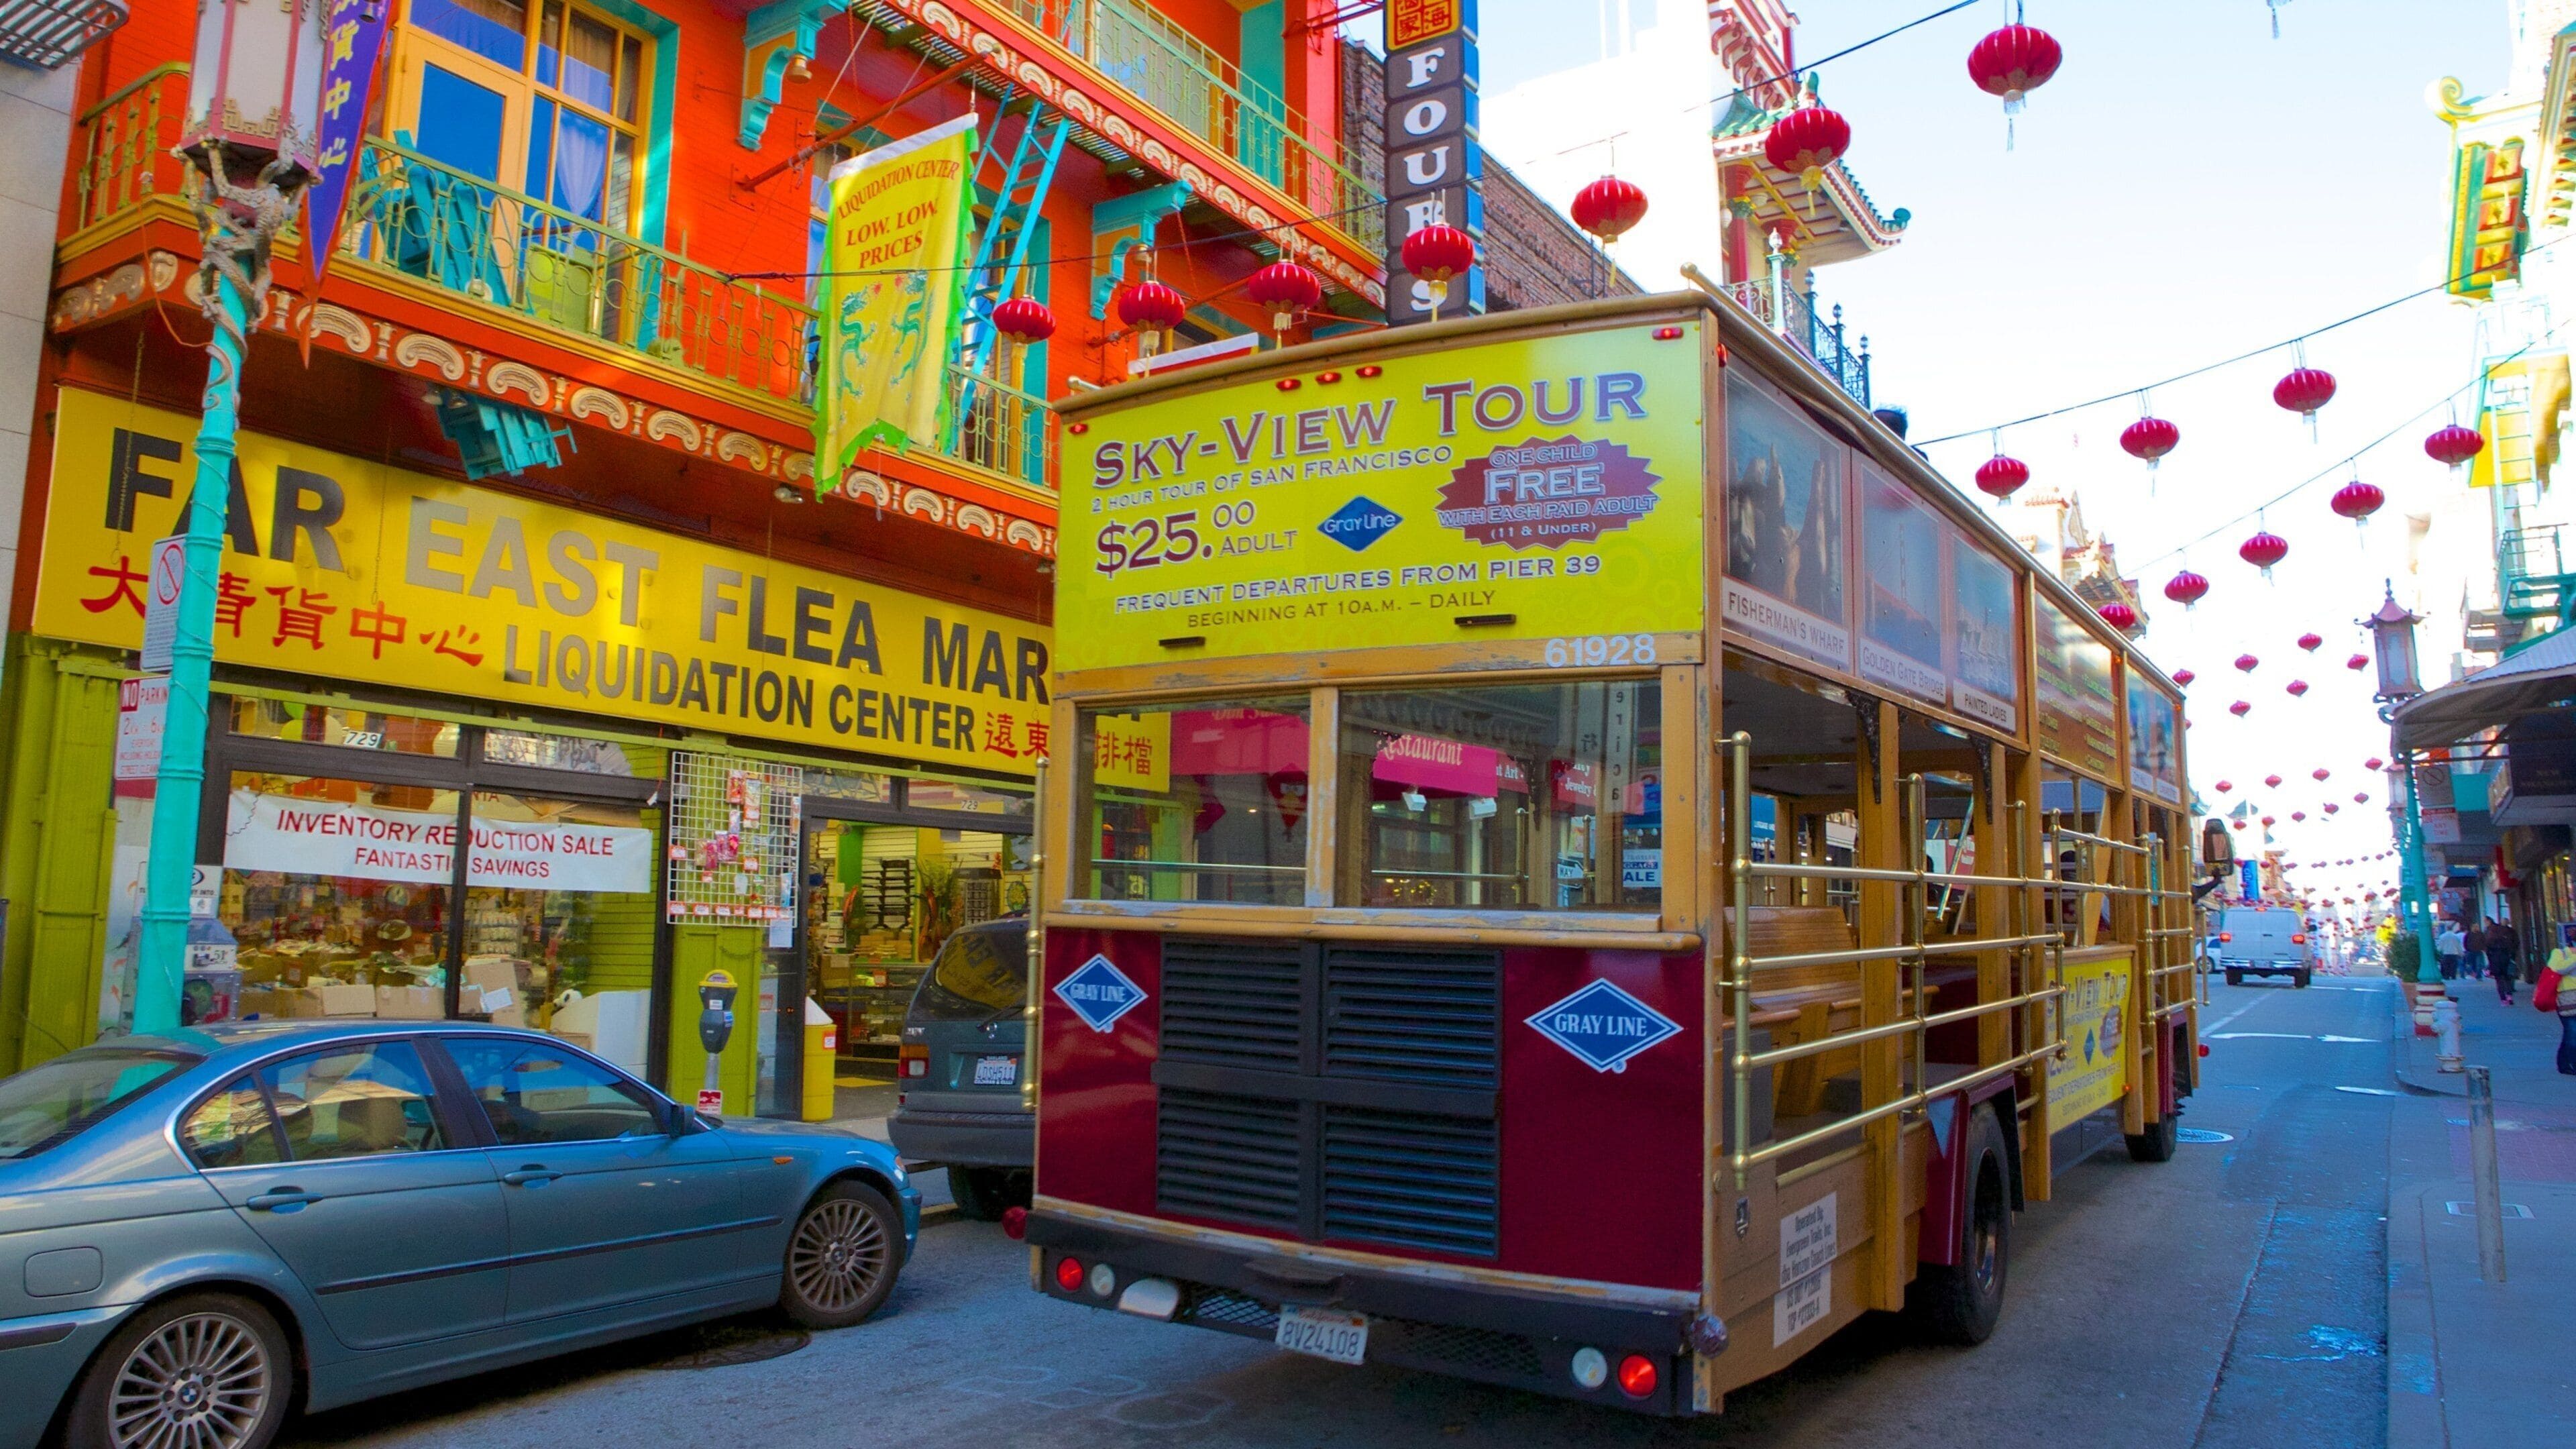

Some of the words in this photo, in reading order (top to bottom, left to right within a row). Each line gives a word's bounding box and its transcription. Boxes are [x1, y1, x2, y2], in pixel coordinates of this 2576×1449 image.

[319, 0, 360, 168] 貨中心
[839, 166, 913, 219] LIQUIDATION
[916, 159, 960, 181] CENTER
[859, 230, 923, 270] PRICES
[1092, 398, 1397, 490] SKY-VIEW
[1423, 371, 1648, 437] TOUR
[1489, 448, 1531, 468] ONE
[1535, 442, 1598, 462] CHILD
[1091, 497, 1102, 514] 2
[1108, 488, 1154, 512] HOUR
[1161, 480, 1207, 500] TOUR
[1214, 472, 1242, 493] OF
[1249, 465, 1295, 488] SAN
[1303, 445, 1452, 480] FRANCISCO
[1483, 463, 1605, 505] FREE
[1438, 506, 1485, 527] WITH
[1488, 502, 1541, 524] EACH
[1543, 498, 1590, 519] PAID
[1593, 494, 1660, 517] ADULT
[1218, 530, 1299, 558] ADULT
[1491, 525, 1505, 540] (11
[1521, 524, 1531, 536] &
[1538, 521, 1598, 537] UNDER)
[104, 427, 346, 572] FAR
[405, 494, 659, 627] EAST
[700, 564, 883, 676] FLEA
[1115, 585, 1225, 615] FREQUENT
[1232, 569, 1393, 600] DEPARTURES
[1399, 562, 1479, 587] FROM
[1489, 557, 1556, 580] PIER
[1565, 555, 1602, 576] 39
[1188, 604, 1297, 629] BEGINNING
[1303, 603, 1326, 619] AT
[1430, 590, 1496, 609] DAILY
[1728, 591, 1807, 641] FISHERMAN'S
[1809, 629, 1845, 653] WHARF
[1544, 633, 1656, 668] 61928
[504, 624, 814, 730] LIQUIDATION
[830, 684, 975, 753] CENTER
[1862, 645, 1895, 672] GOLDEN
[1898, 661, 1917, 686] GATE
[1918, 672, 1944, 697] BRIDGE
[121, 682, 138, 707] NO
[1964, 692, 1988, 714] PAINTED
[1988, 700, 2007, 723] LADIES
[346, 731, 379, 748] 729
[961, 800, 979, 810] 729
[276, 809, 427, 843] INVENTORY
[562, 835, 614, 857] SALE
[472, 857, 551, 879] SAVINGS
[1069, 983, 1100, 1001] GRAY
[1100, 985, 1126, 1003] LINE
[1554, 1013, 1603, 1034] GRAY
[1606, 1016, 1648, 1037] LINE
[1282, 1320, 1360, 1356] 8V24108
